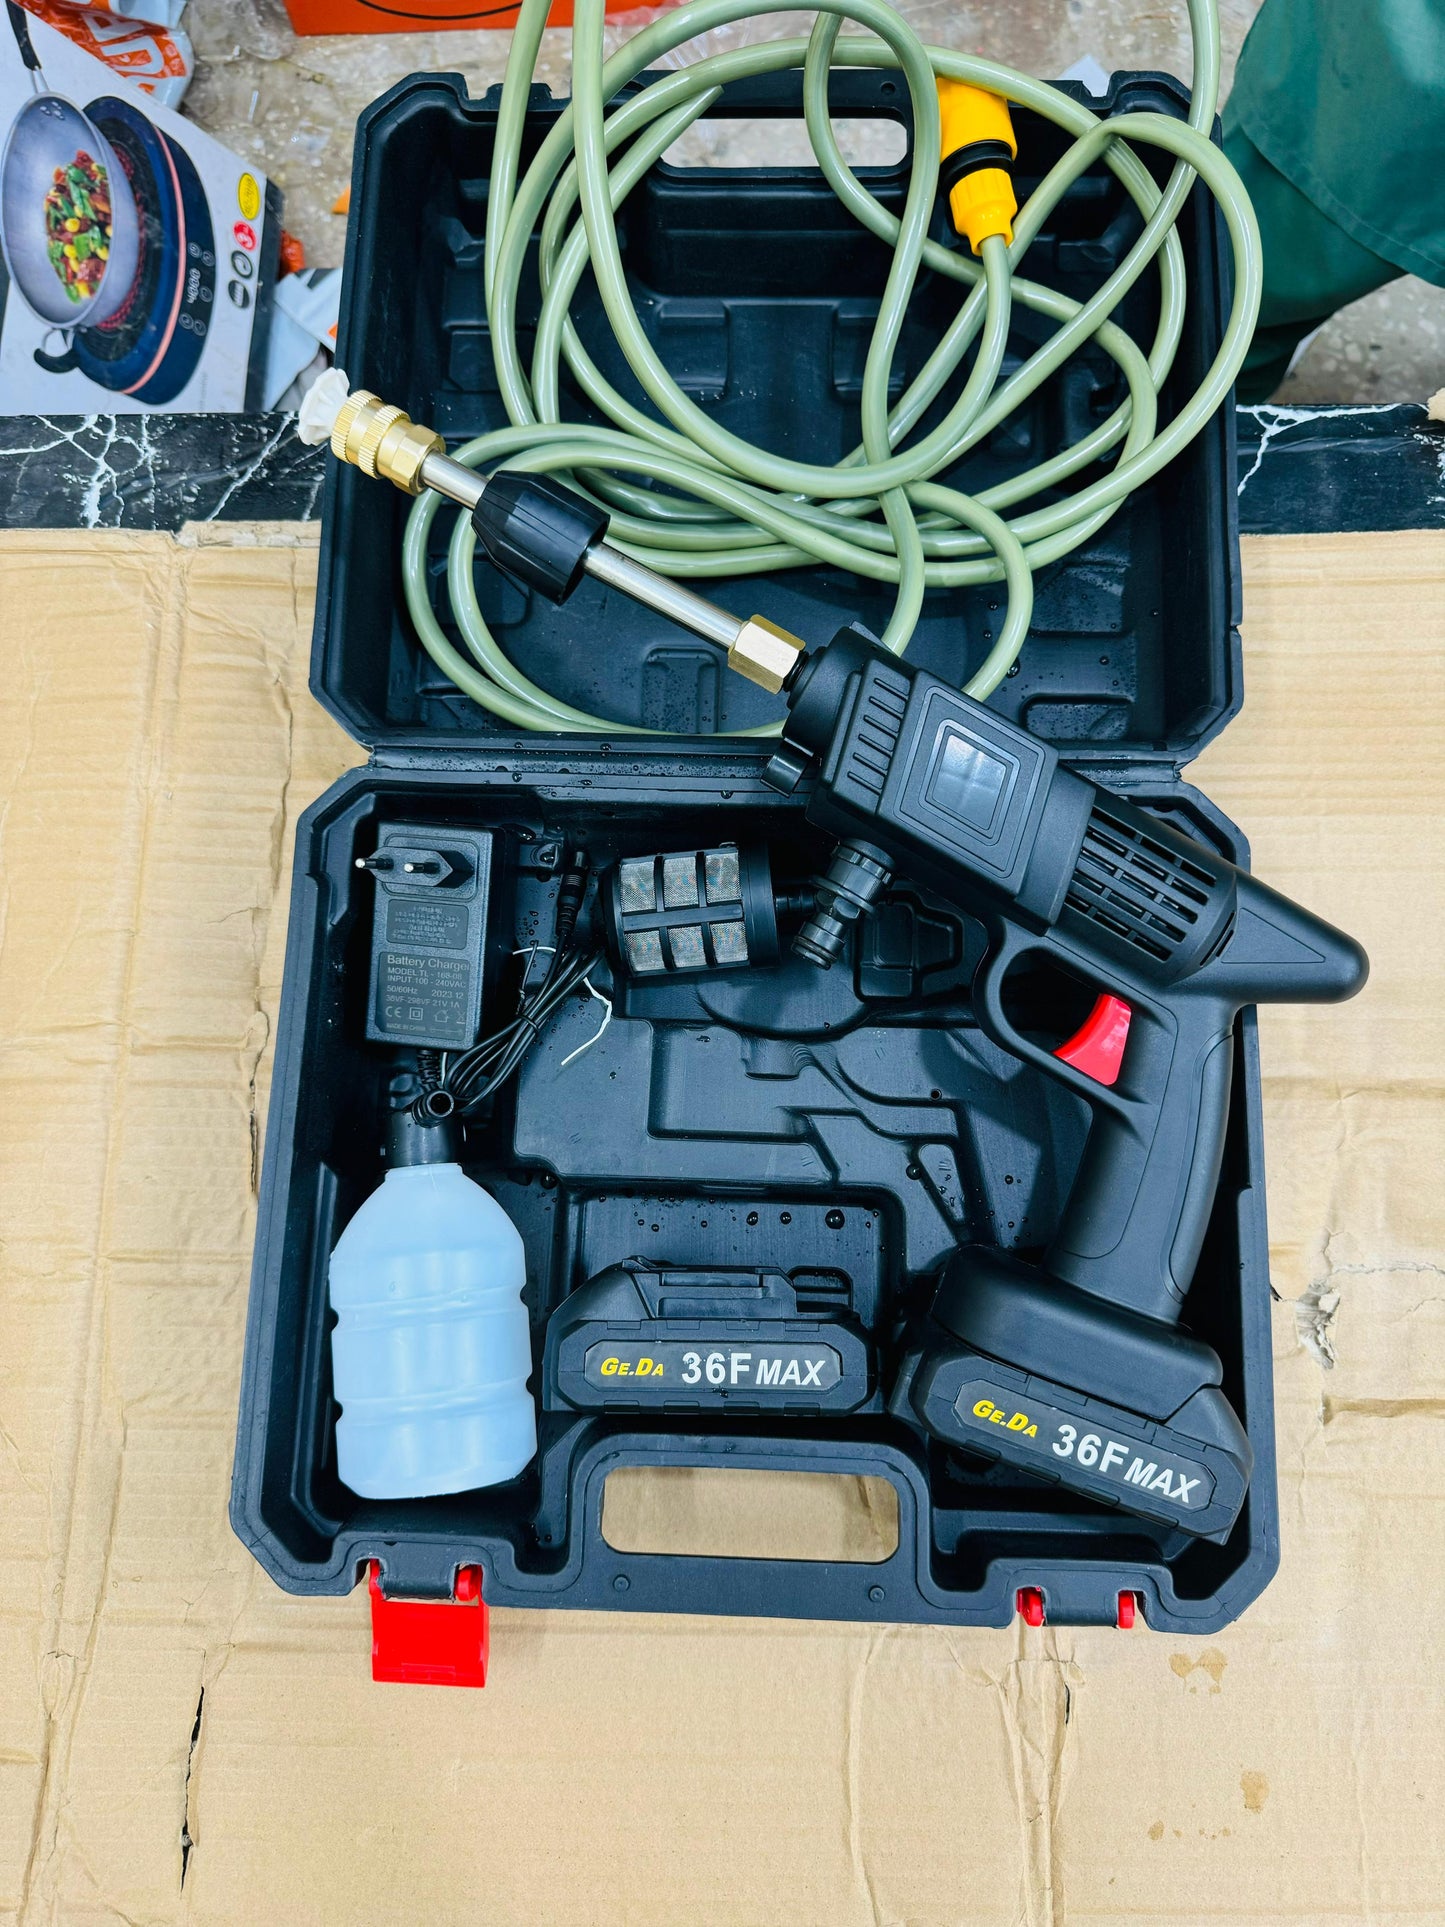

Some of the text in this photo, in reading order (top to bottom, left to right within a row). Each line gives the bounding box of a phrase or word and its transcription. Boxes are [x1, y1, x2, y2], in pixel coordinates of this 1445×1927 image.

[388, 955, 425, 969] Battery
[386, 985, 418, 994] 50/60Hz
[681, 1351, 752, 1385] 36F
[755, 1359, 826, 1386] MAX
[1052, 1424, 1129, 1473] 36F
[1123, 1458, 1201, 1504] MAX
